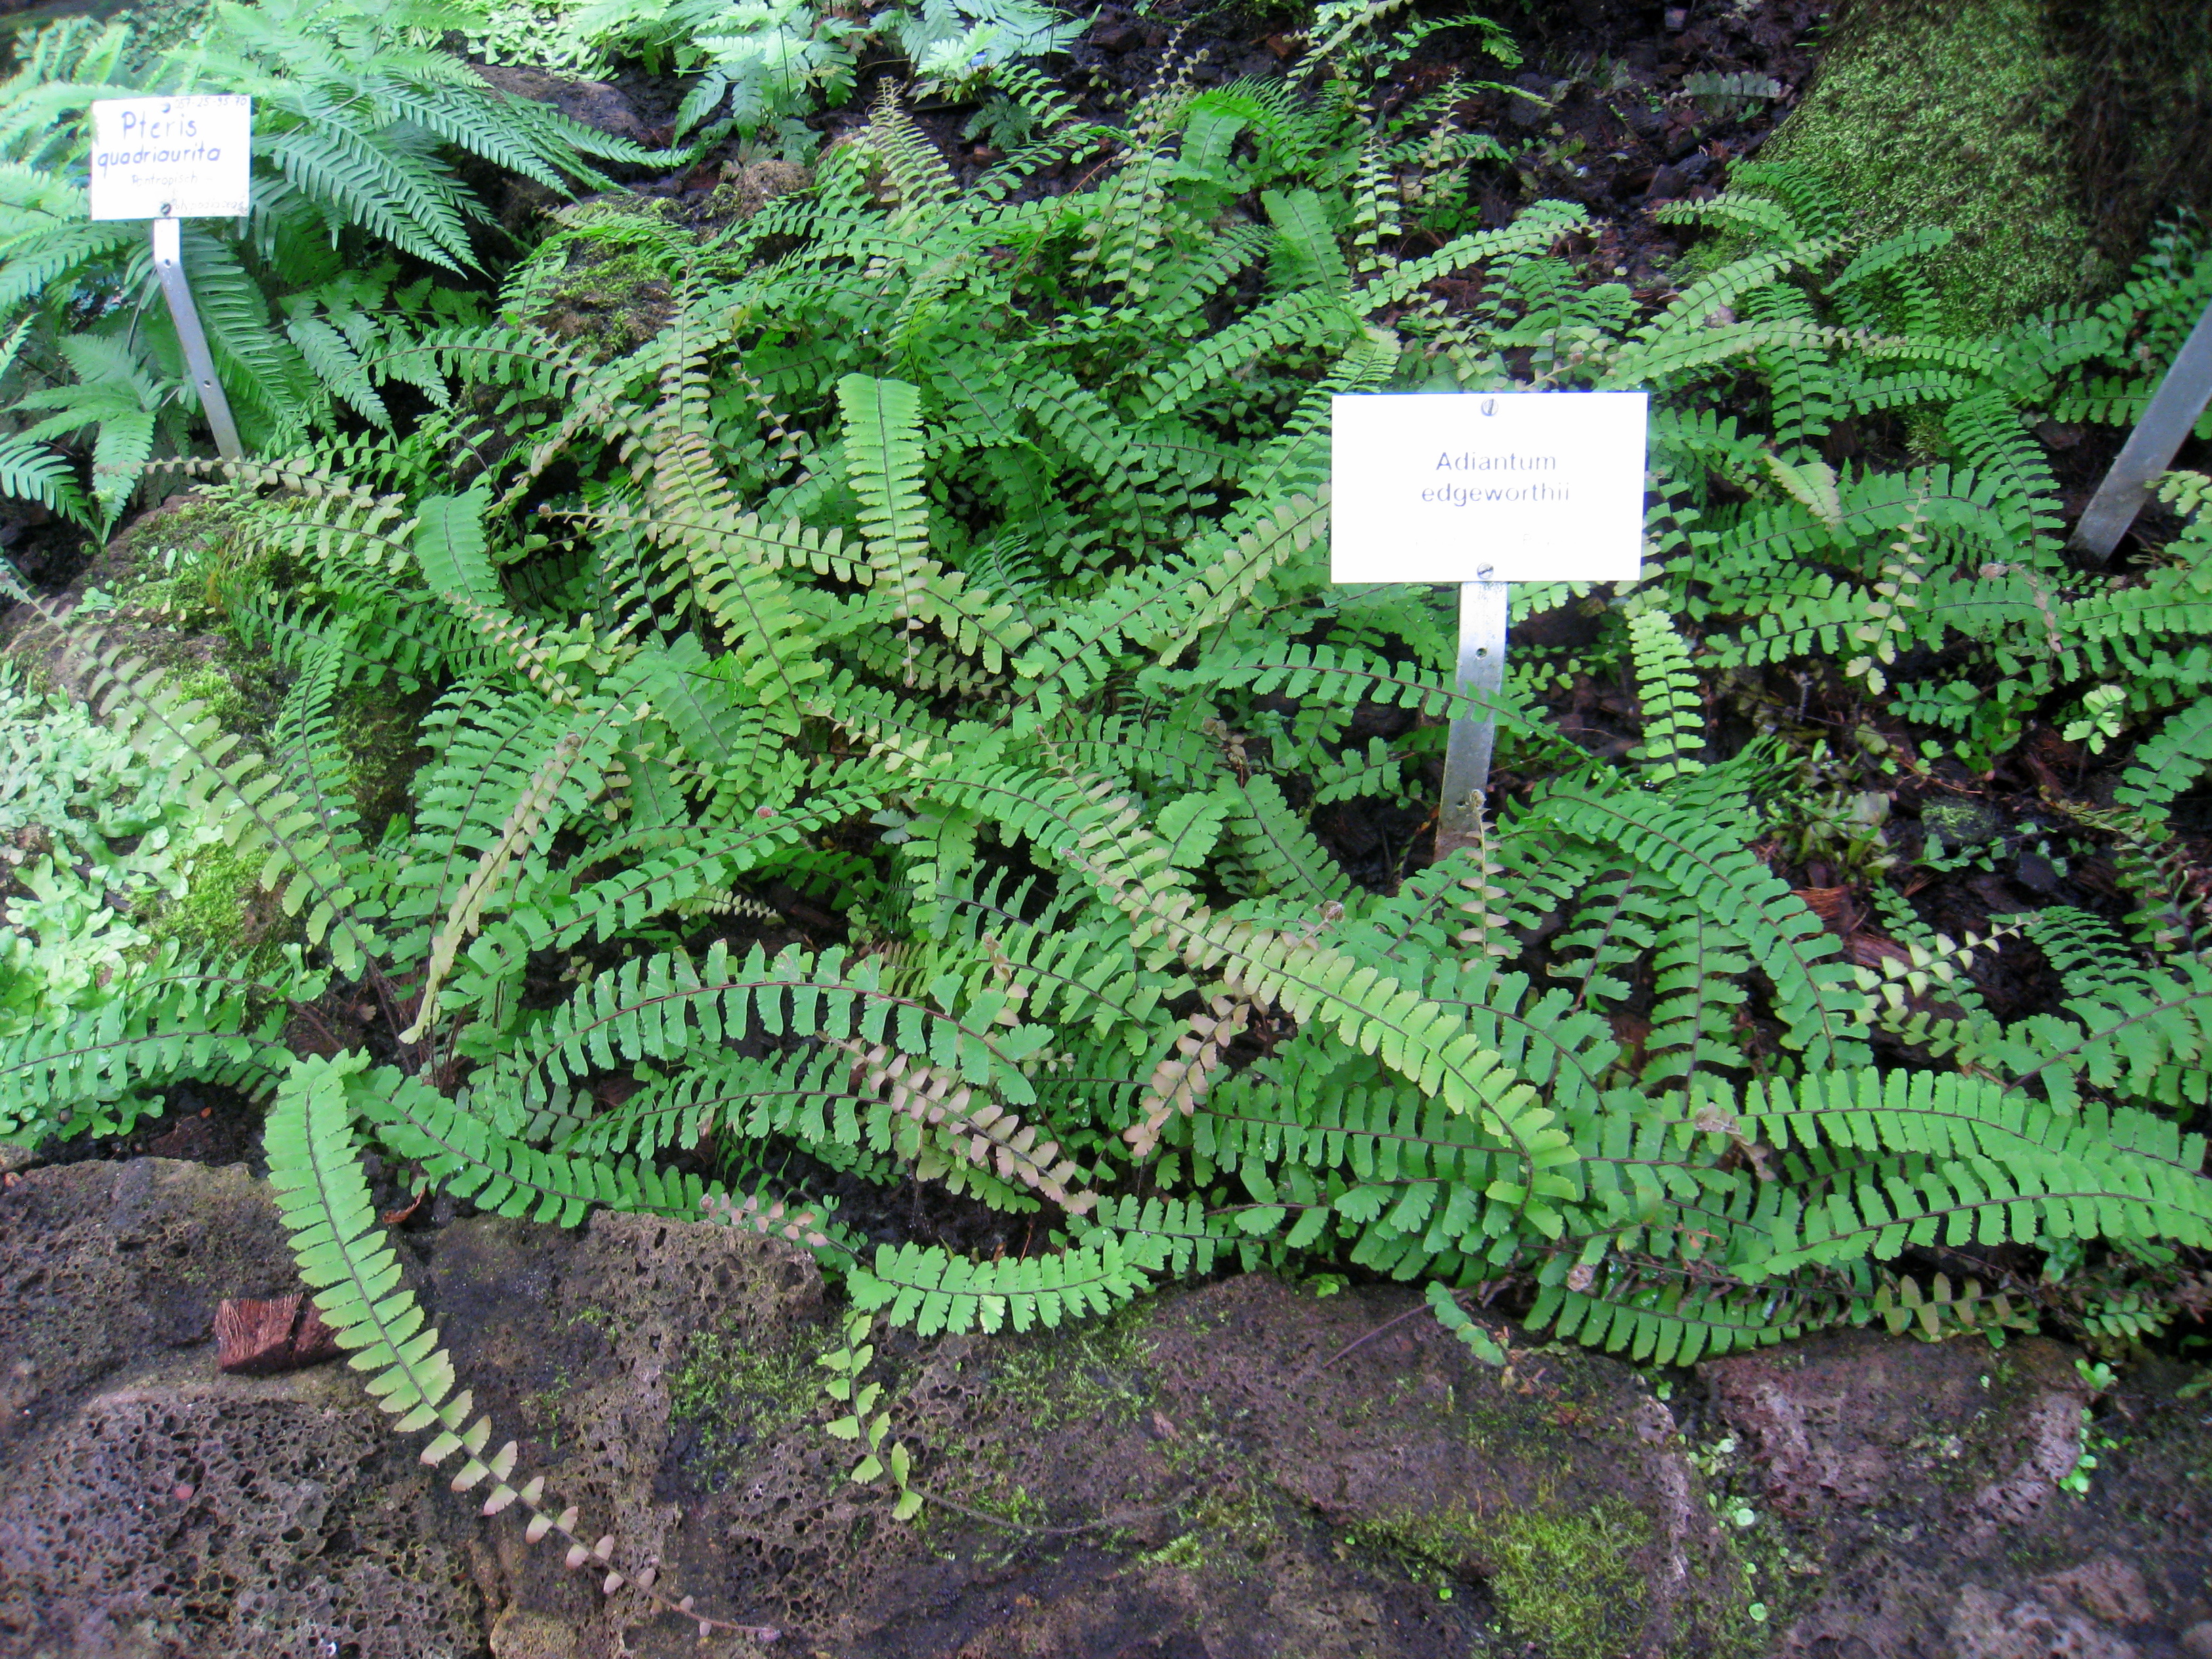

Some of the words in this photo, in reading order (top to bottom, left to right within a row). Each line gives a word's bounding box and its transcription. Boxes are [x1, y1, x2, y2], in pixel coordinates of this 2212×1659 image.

[121, 110, 197, 140] Pteris
[97, 140, 222, 179] quadriaurita
[1435, 451, 1557, 471] Adiantum
[1421, 482, 1570, 507] edgeworthii
